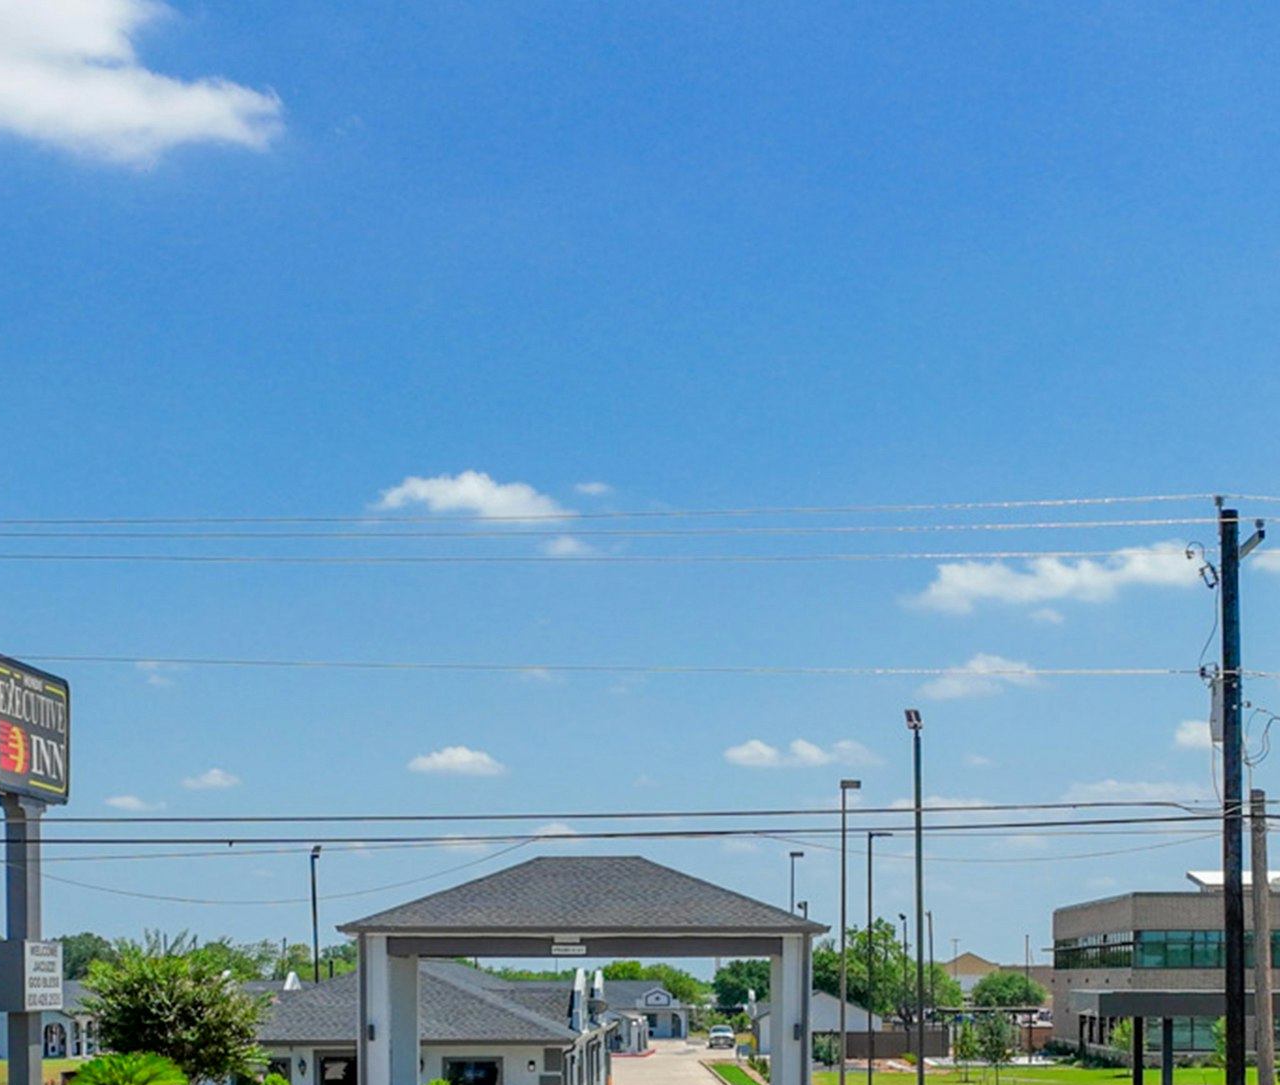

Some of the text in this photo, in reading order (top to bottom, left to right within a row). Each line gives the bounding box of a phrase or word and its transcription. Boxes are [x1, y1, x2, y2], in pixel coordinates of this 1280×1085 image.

[30, 735, 65, 781] INN
[30, 945, 58, 957] WELCOME
[29, 976, 41, 988] GOD
